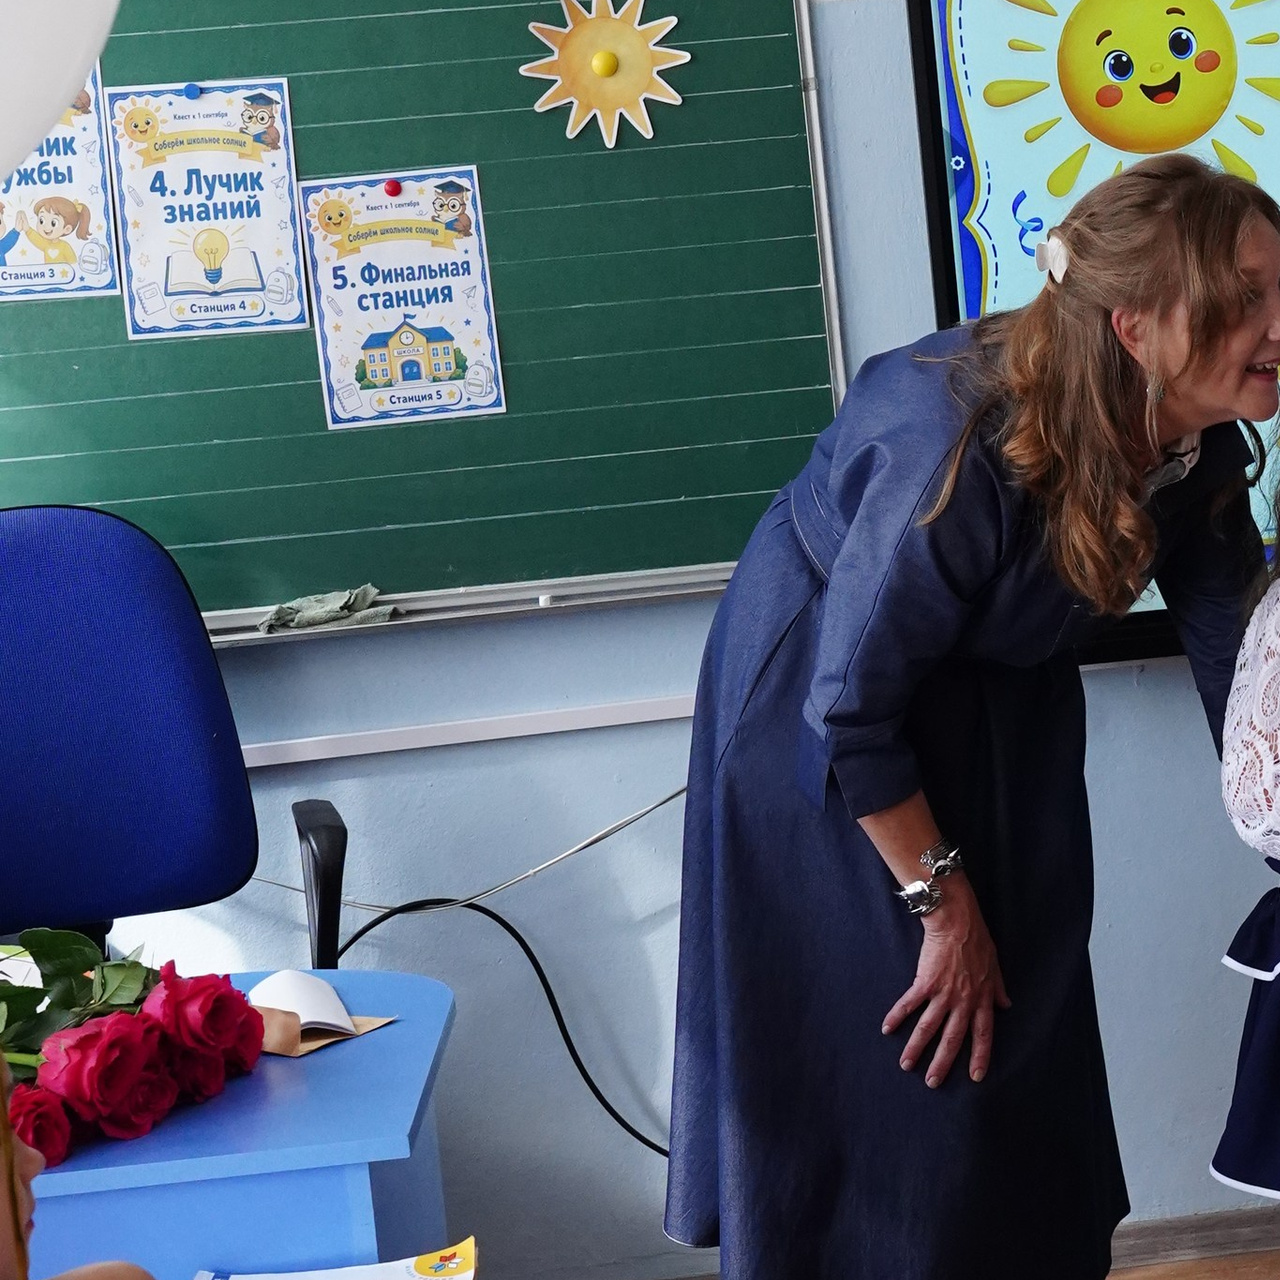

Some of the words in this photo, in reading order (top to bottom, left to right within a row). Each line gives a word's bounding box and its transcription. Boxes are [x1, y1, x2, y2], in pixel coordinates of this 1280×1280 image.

[173, 113, 191, 122] Квест
[202, 111, 229, 121] сентября
[154, 137, 185, 152] Соберём
[186, 135, 221, 148] школьное
[222, 135, 248, 148] солнце
[150, 170, 176, 198] 4.
[184, 167, 265, 201] Лучик
[163, 195, 262, 224] знаний
[395, 201, 419, 210] сентября
[348, 229, 377, 243] Соберём
[380, 226, 413, 236] школьное
[416, 227, 439, 237] солнце
[1, 270, 46, 282] Станция
[48, 268, 56, 279] 3
[332, 265, 356, 290] 5.
[360, 260, 471, 286] Финальная
[357, 285, 453, 312] станция
[190, 303, 236, 315] Станция
[239, 300, 247, 311] 4
[390, 392, 433, 405] Станция
[436, 390, 443, 400] 5
